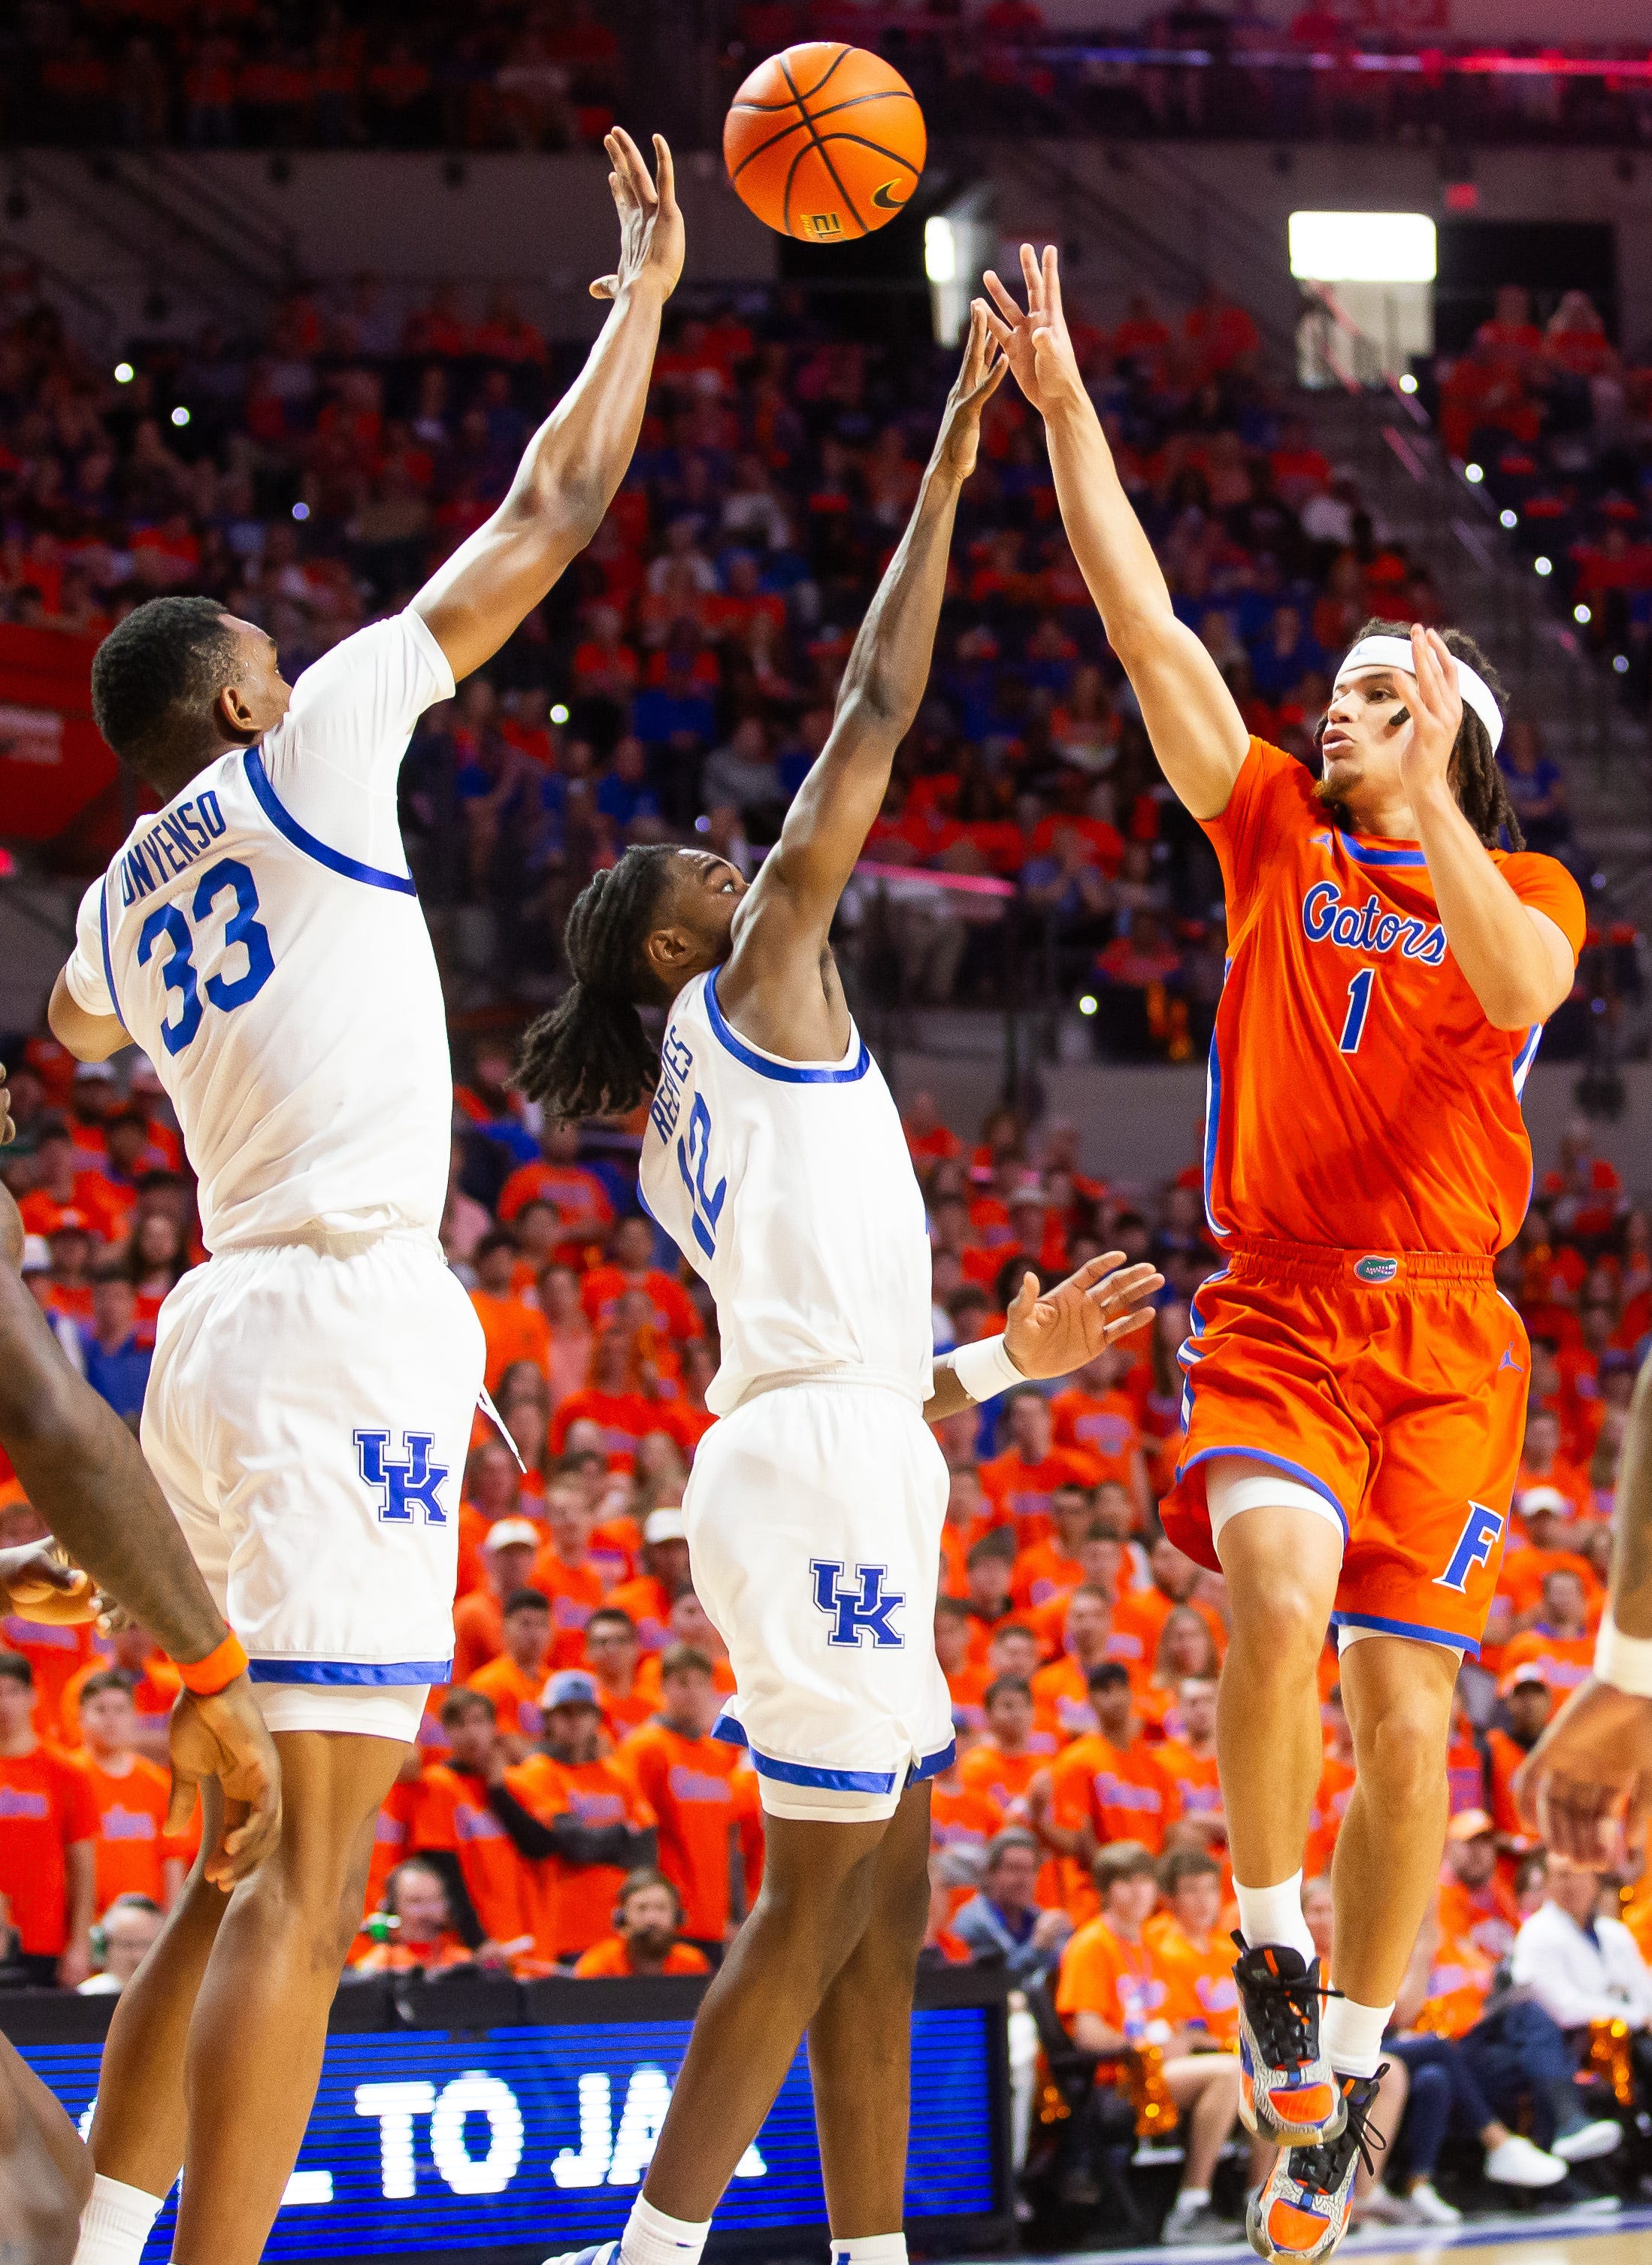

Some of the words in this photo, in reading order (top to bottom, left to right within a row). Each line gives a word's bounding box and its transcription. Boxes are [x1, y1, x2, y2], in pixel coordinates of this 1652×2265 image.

[120, 790, 227, 908] ONYENSO
[137, 857, 276, 1057] 33
[1302, 880, 1448, 966] Gators
[1339, 967, 1376, 1054] 1
[649, 1025, 694, 1146] REEVES
[677, 1091, 728, 1253] 12
[353, 1429, 449, 1528] UK
[1431, 1499, 1505, 1594] F
[809, 1558, 906, 1649] UK
[355, 2071, 525, 2200] TO
